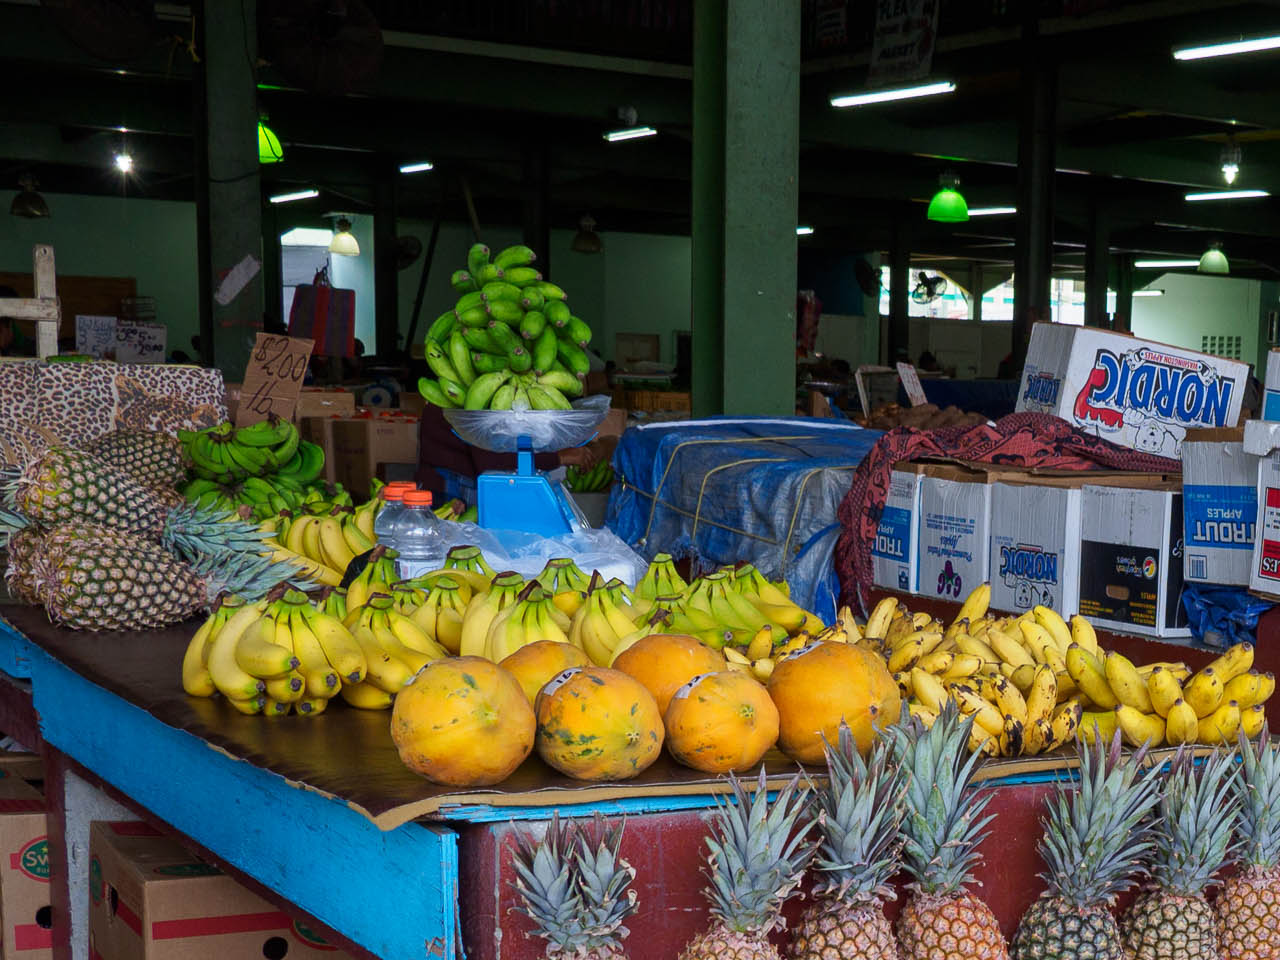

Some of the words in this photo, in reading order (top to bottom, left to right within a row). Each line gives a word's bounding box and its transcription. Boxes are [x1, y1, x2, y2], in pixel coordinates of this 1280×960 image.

[1143, 351, 1163, 363] APPLES
[1163, 355, 1199, 370] WASHINGTON
[1093, 349, 1235, 428] NORDIC
[1207, 508, 1243, 520] APPLES
[1193, 520, 1256, 544] TROUT
[1000, 546, 1058, 585] NORDIC
